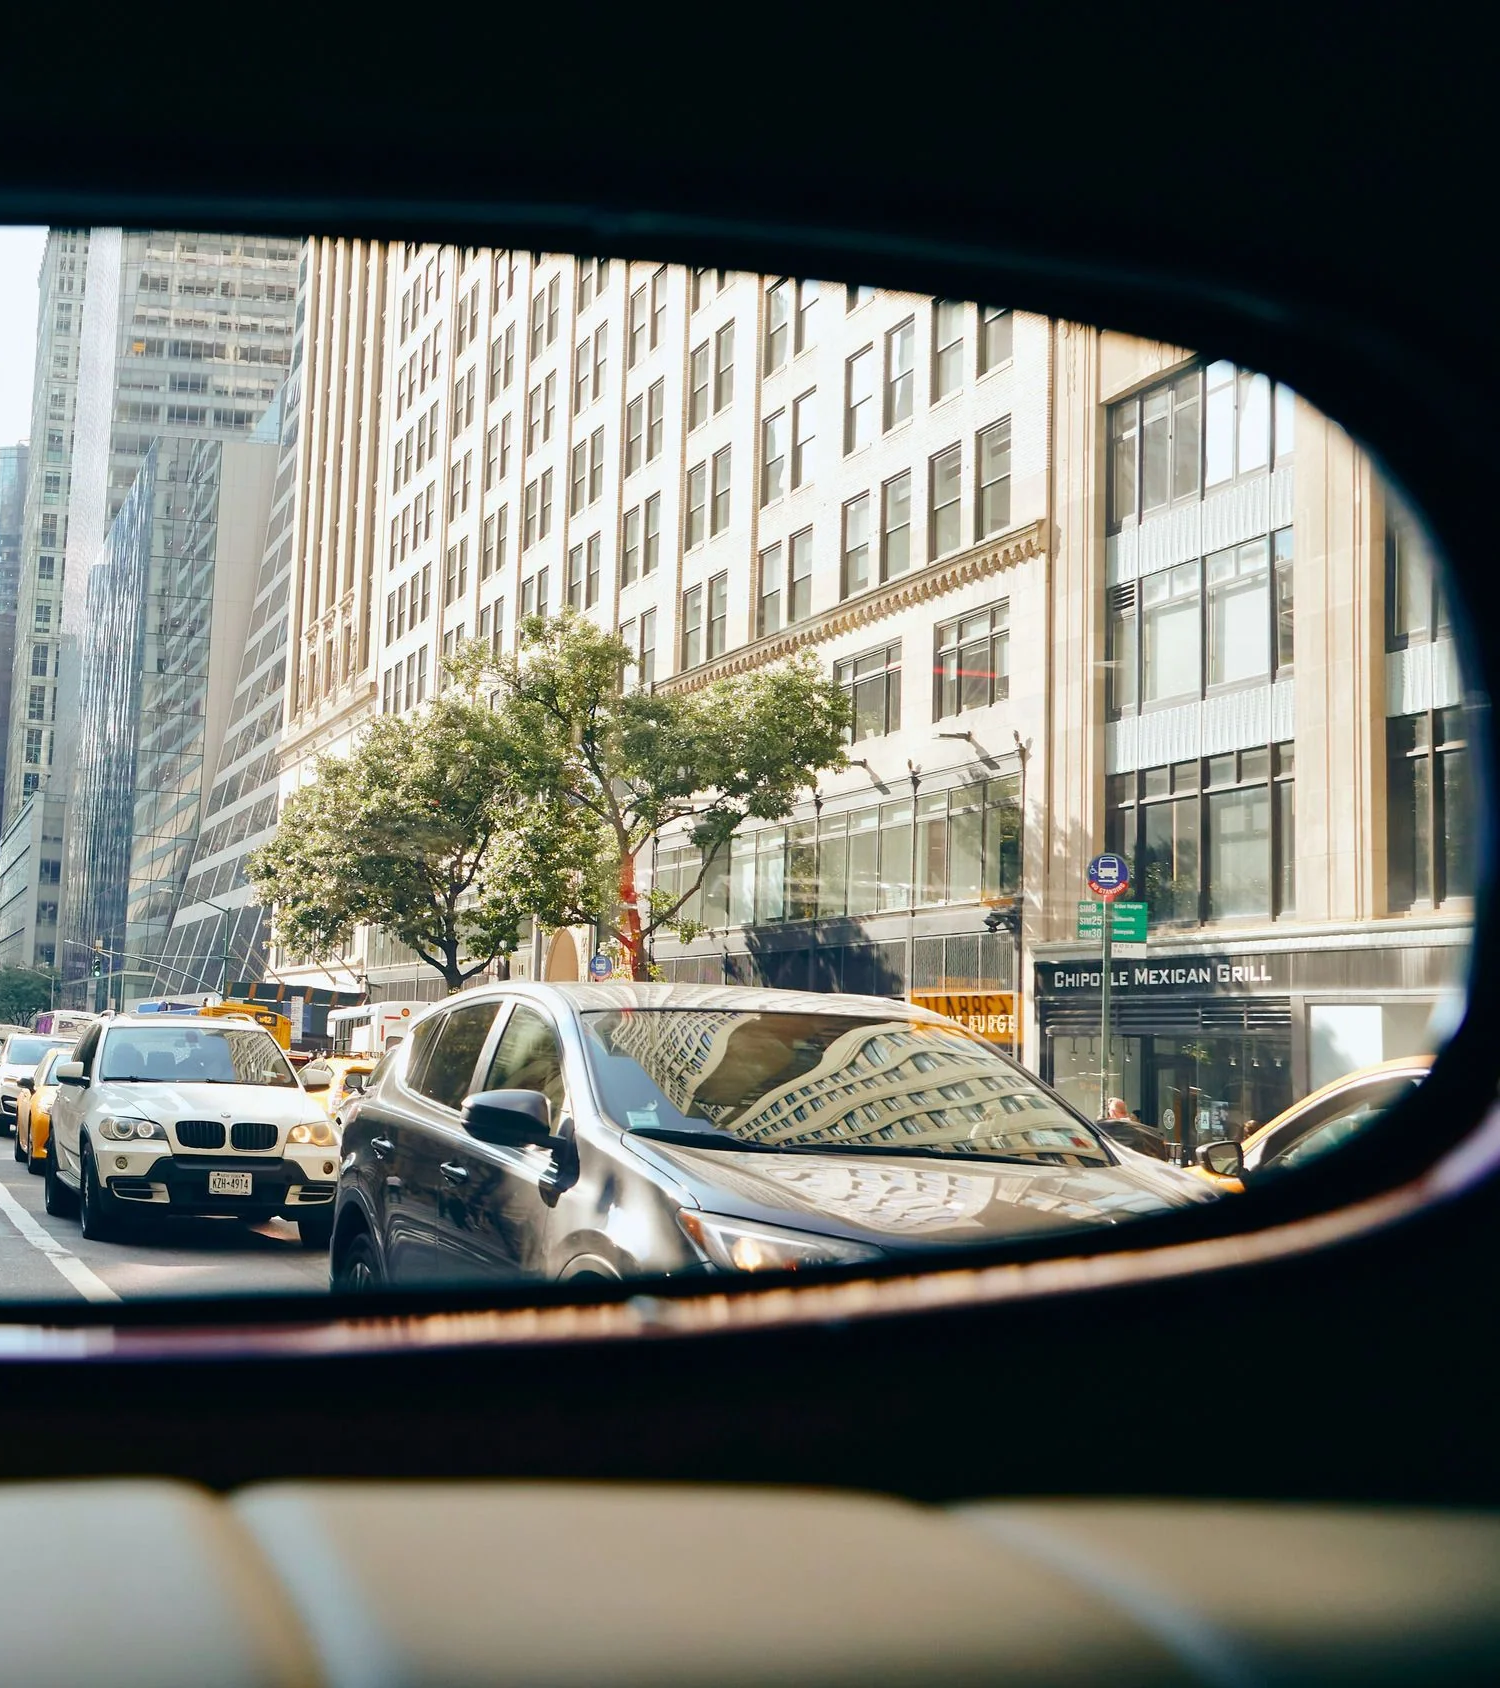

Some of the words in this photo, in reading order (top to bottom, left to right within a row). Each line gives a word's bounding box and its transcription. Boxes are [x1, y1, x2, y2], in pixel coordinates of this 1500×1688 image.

[1090, 882, 1098, 890] NO
[1099, 882, 1126, 895] STANDING
[1080, 904, 1096, 913] SIM8
[1080, 916, 1102, 925] SIM25
[1080, 929, 1102, 938] SIM30
[1054, 971, 1128, 988] CHIPOLE
[1134, 968, 1210, 986] MEXICAN
[1216, 964, 1272, 983] GRILL
